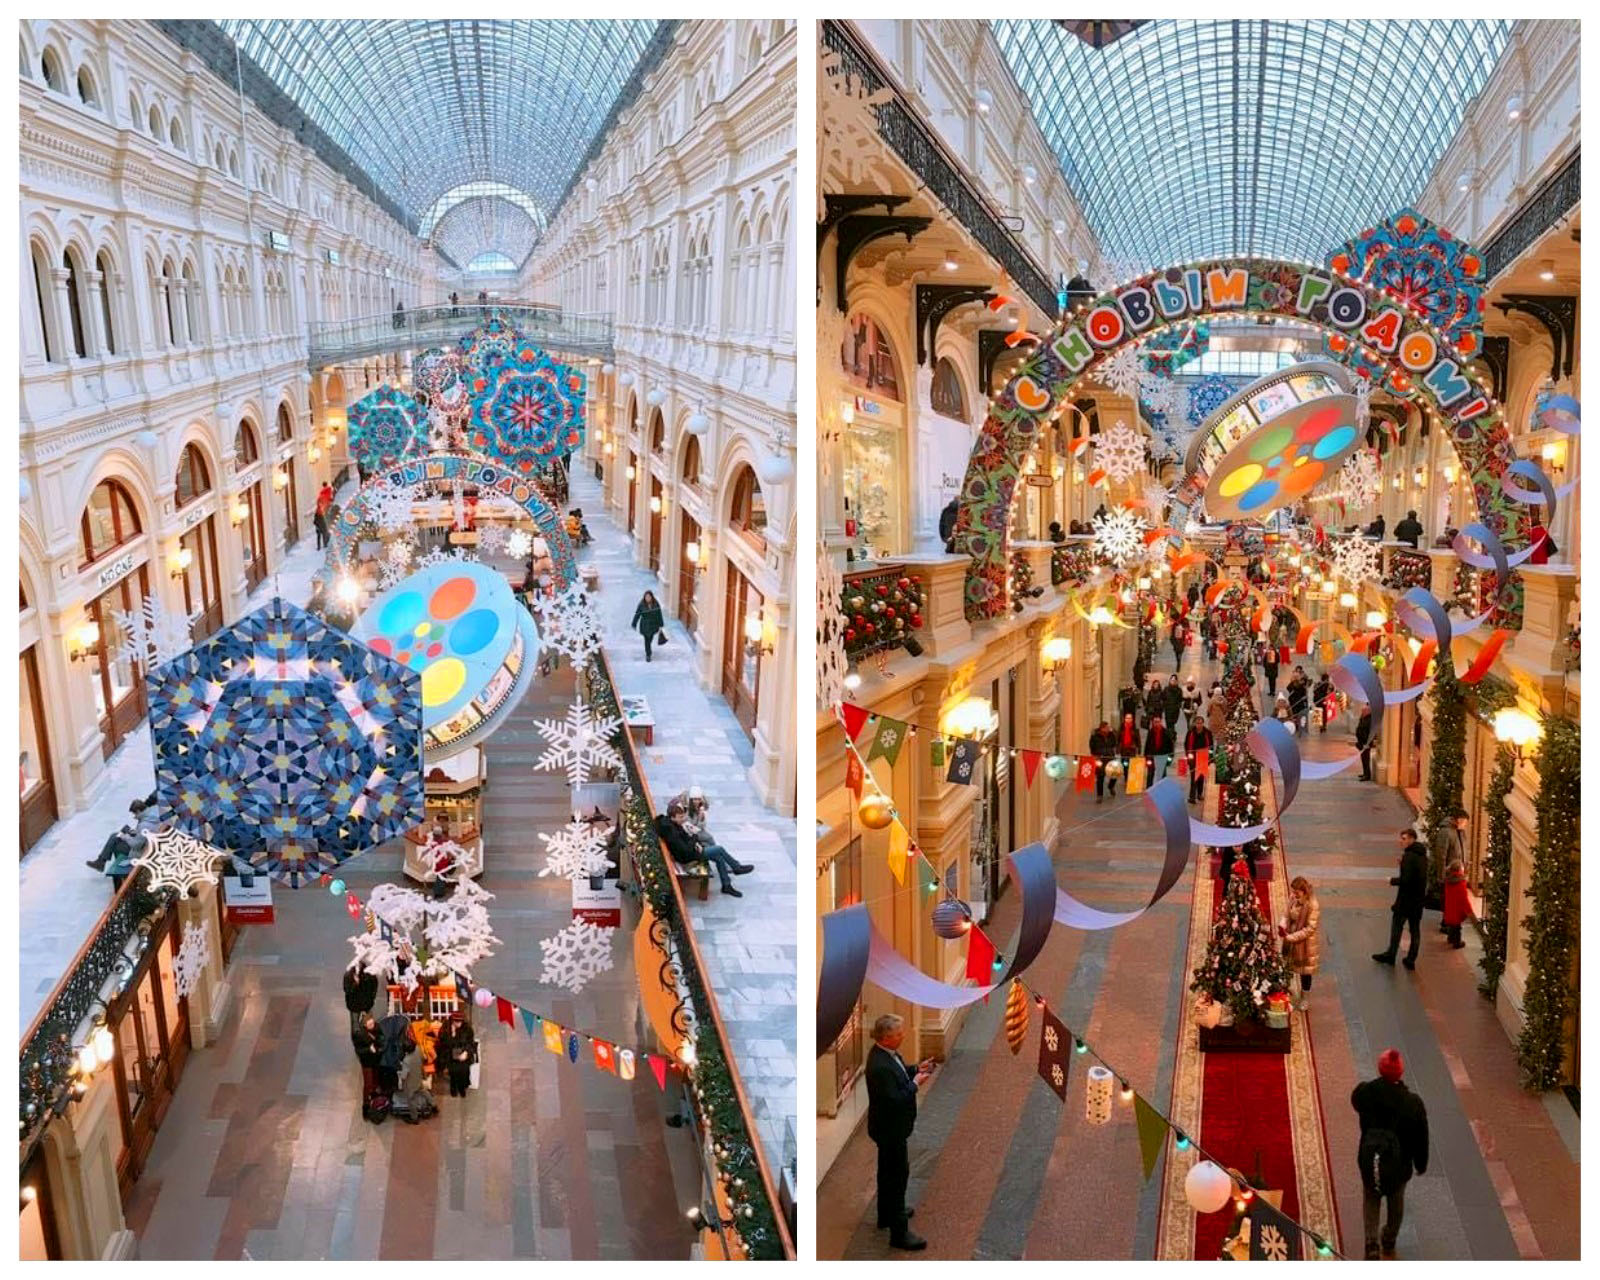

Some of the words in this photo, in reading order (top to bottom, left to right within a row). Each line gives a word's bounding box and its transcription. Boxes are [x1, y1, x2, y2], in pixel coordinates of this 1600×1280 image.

[1015, 375, 1050, 410] С
[1051, 269, 1249, 372] НОВЫМ
[1296, 274, 1489, 424] ГОДОМ!
[467, 462, 553, 524] ГОДОМ!
